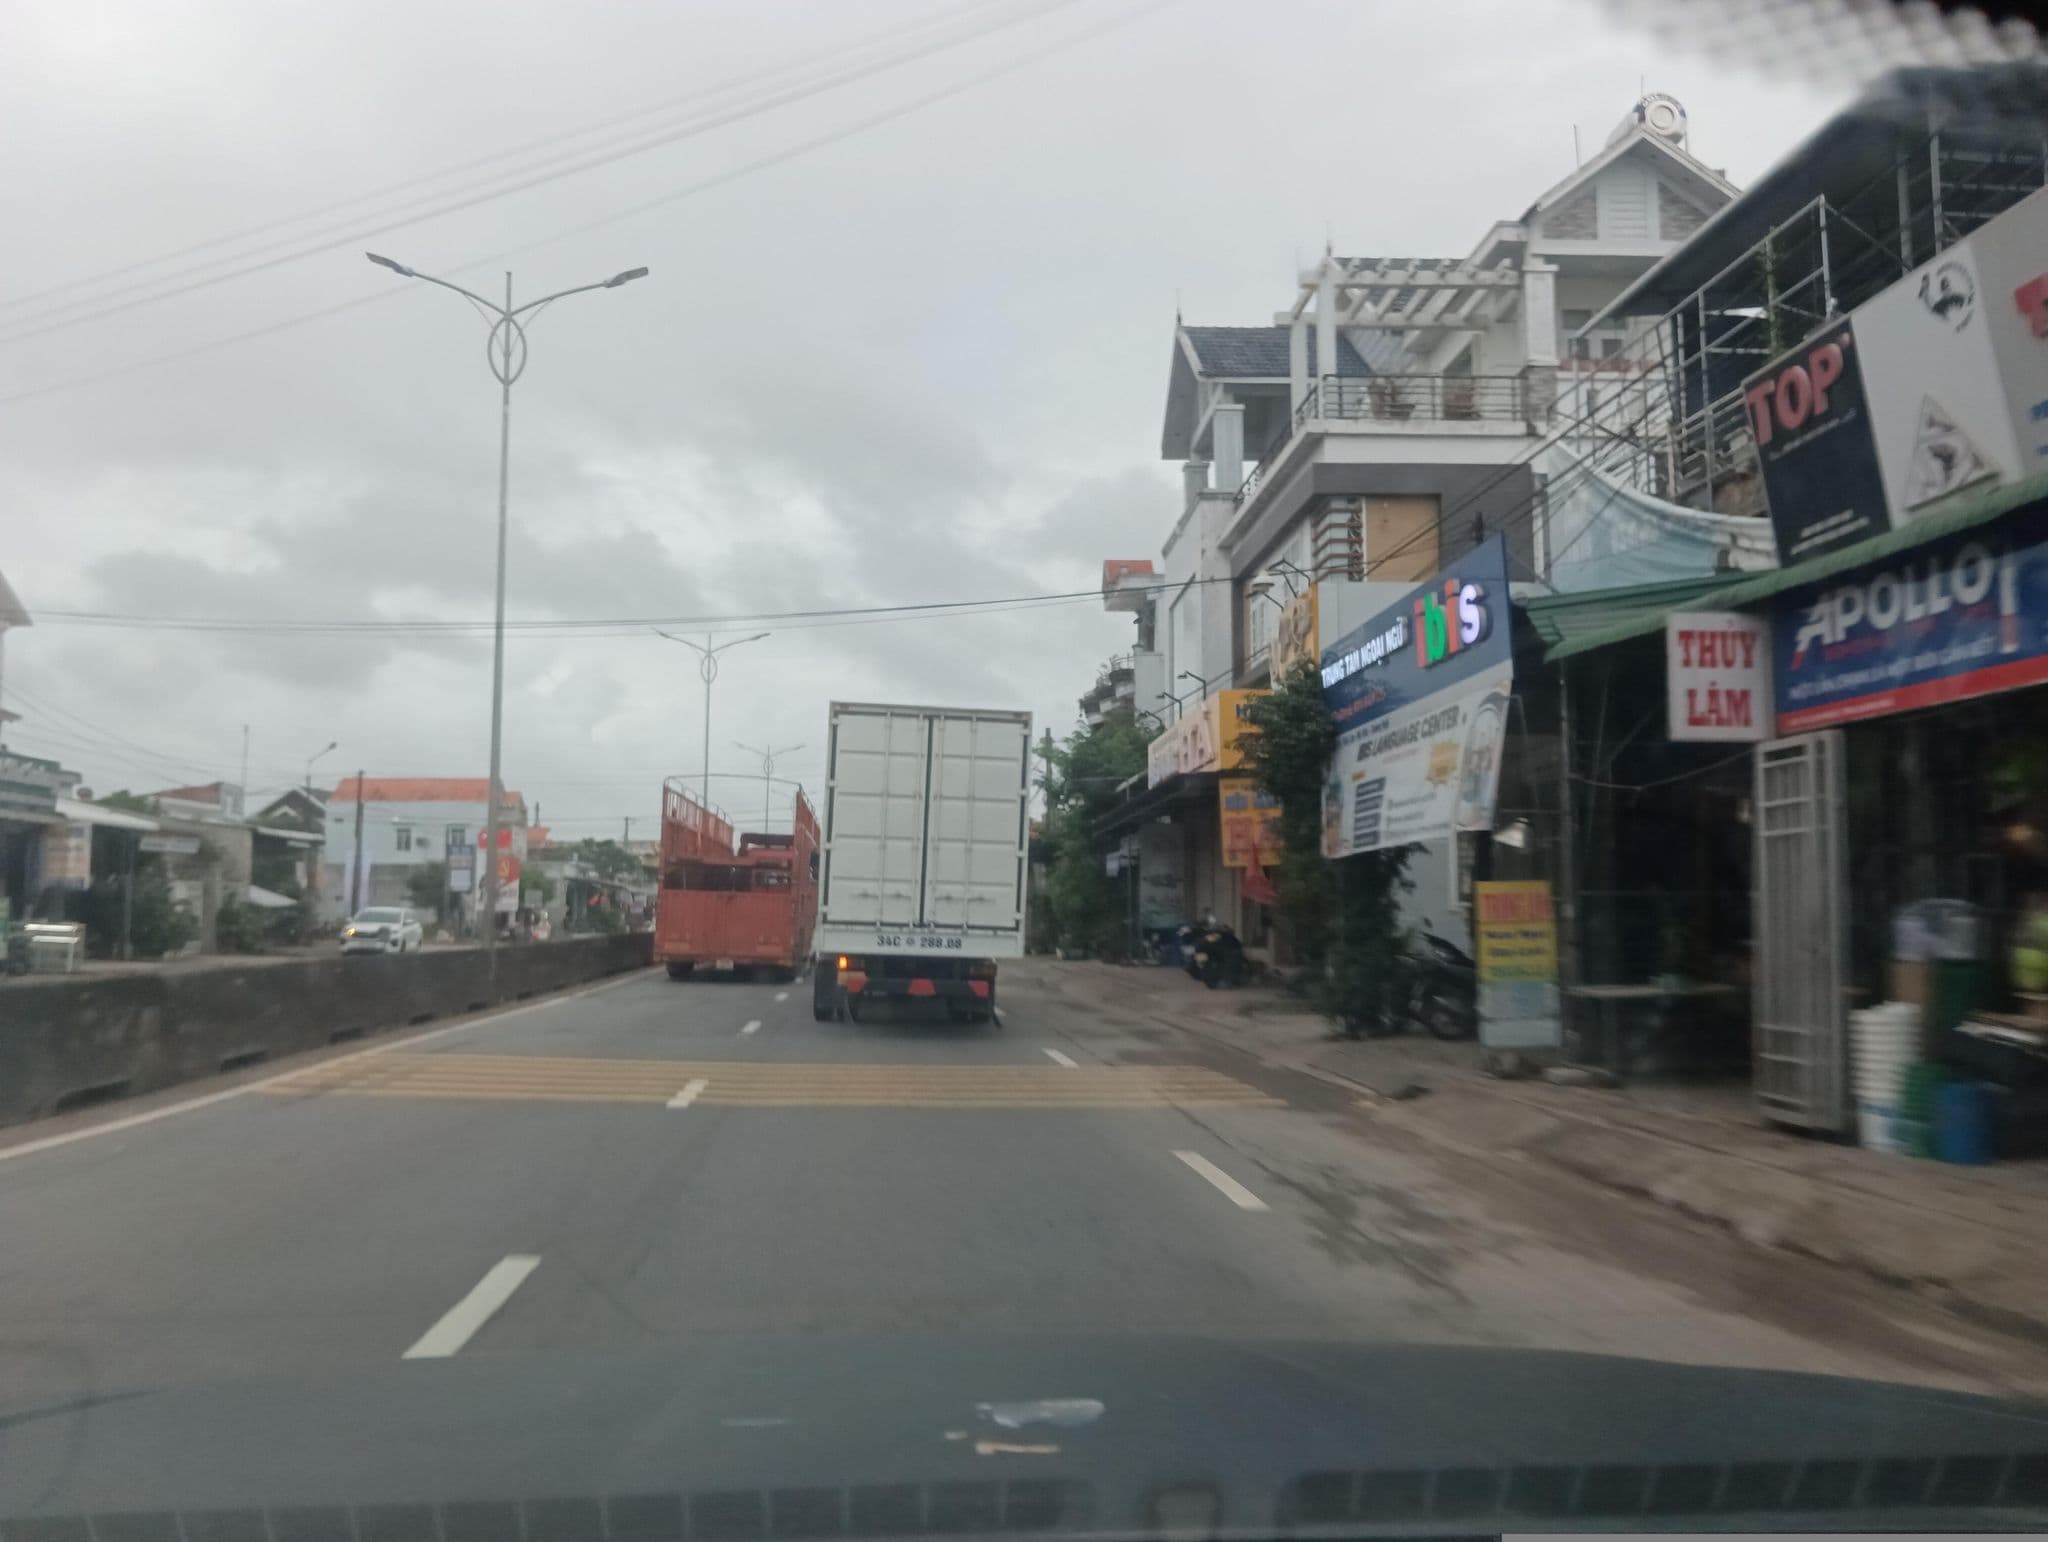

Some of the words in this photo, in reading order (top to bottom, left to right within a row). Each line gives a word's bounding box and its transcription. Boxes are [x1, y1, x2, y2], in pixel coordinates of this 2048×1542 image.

[1745, 342, 1845, 447] TOP
[1414, 578, 1486, 669] ibis
[1792, 545, 1994, 668] APOLLO
